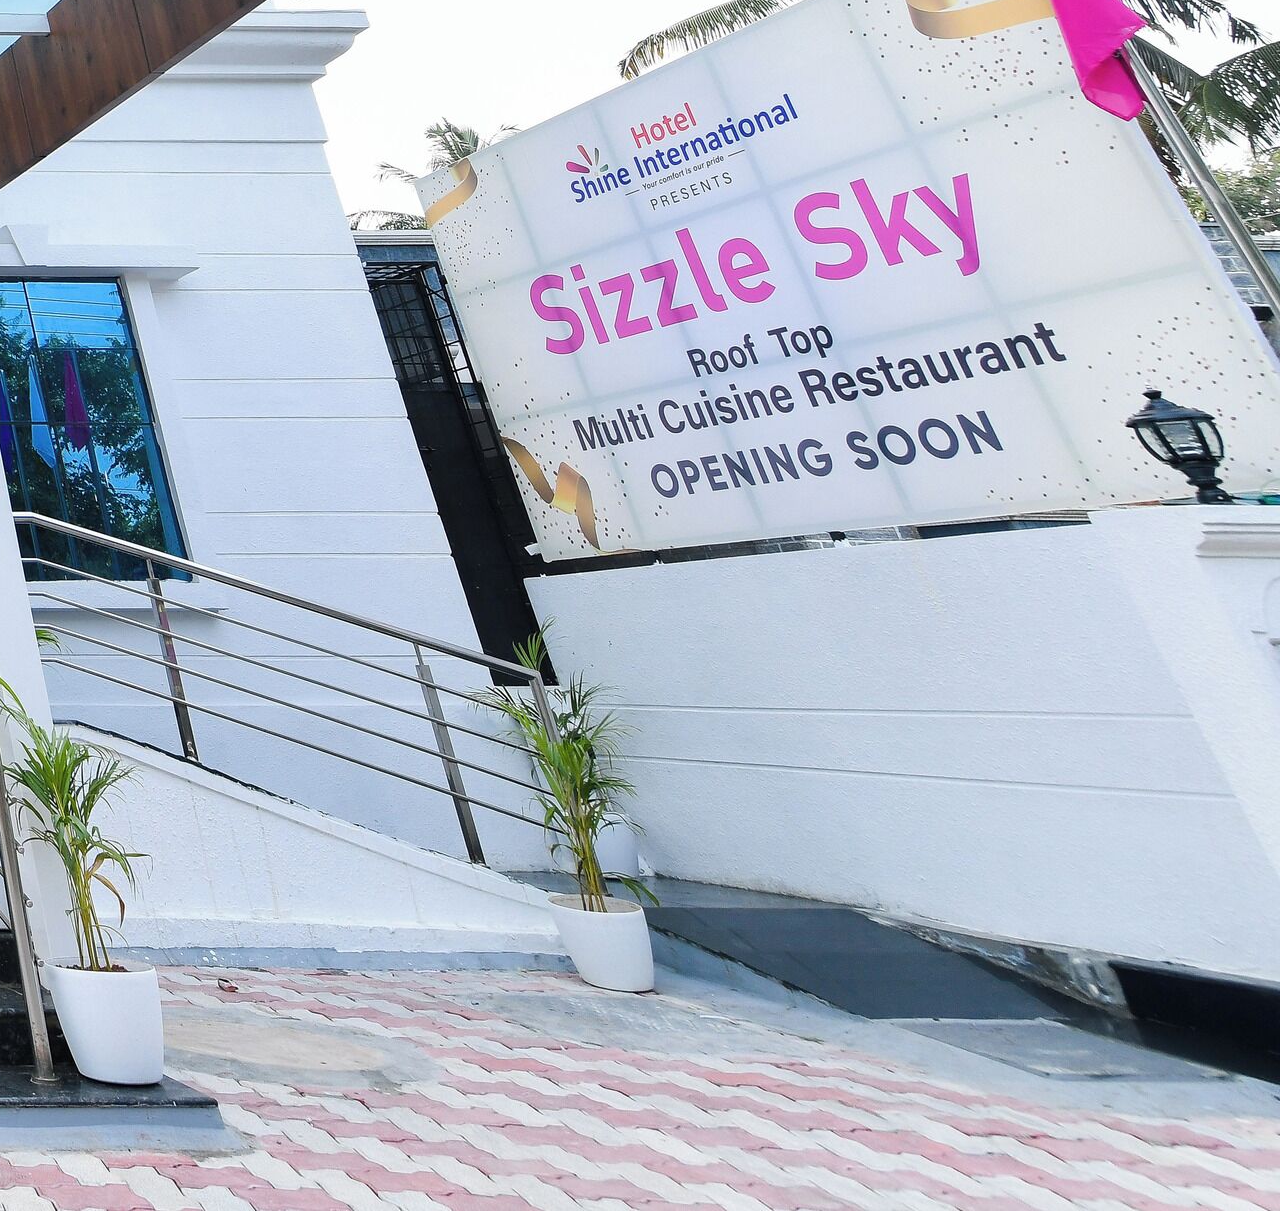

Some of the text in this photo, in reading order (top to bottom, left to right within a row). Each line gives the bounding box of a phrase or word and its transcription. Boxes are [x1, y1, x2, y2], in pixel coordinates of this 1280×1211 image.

[570, 93, 799, 203] Shine International
[630, 102, 697, 149] Hotel
[642, 154, 725, 191] Your comfort is our pride
[650, 172, 733, 210] PRESENTS
[529, 173, 981, 355] Sizzle Sky
[686, 323, 835, 378] Roof Top
[572, 321, 1067, 452] Multi Cuisine Restaurant
[650, 411, 1004, 499] OPENING SOON
